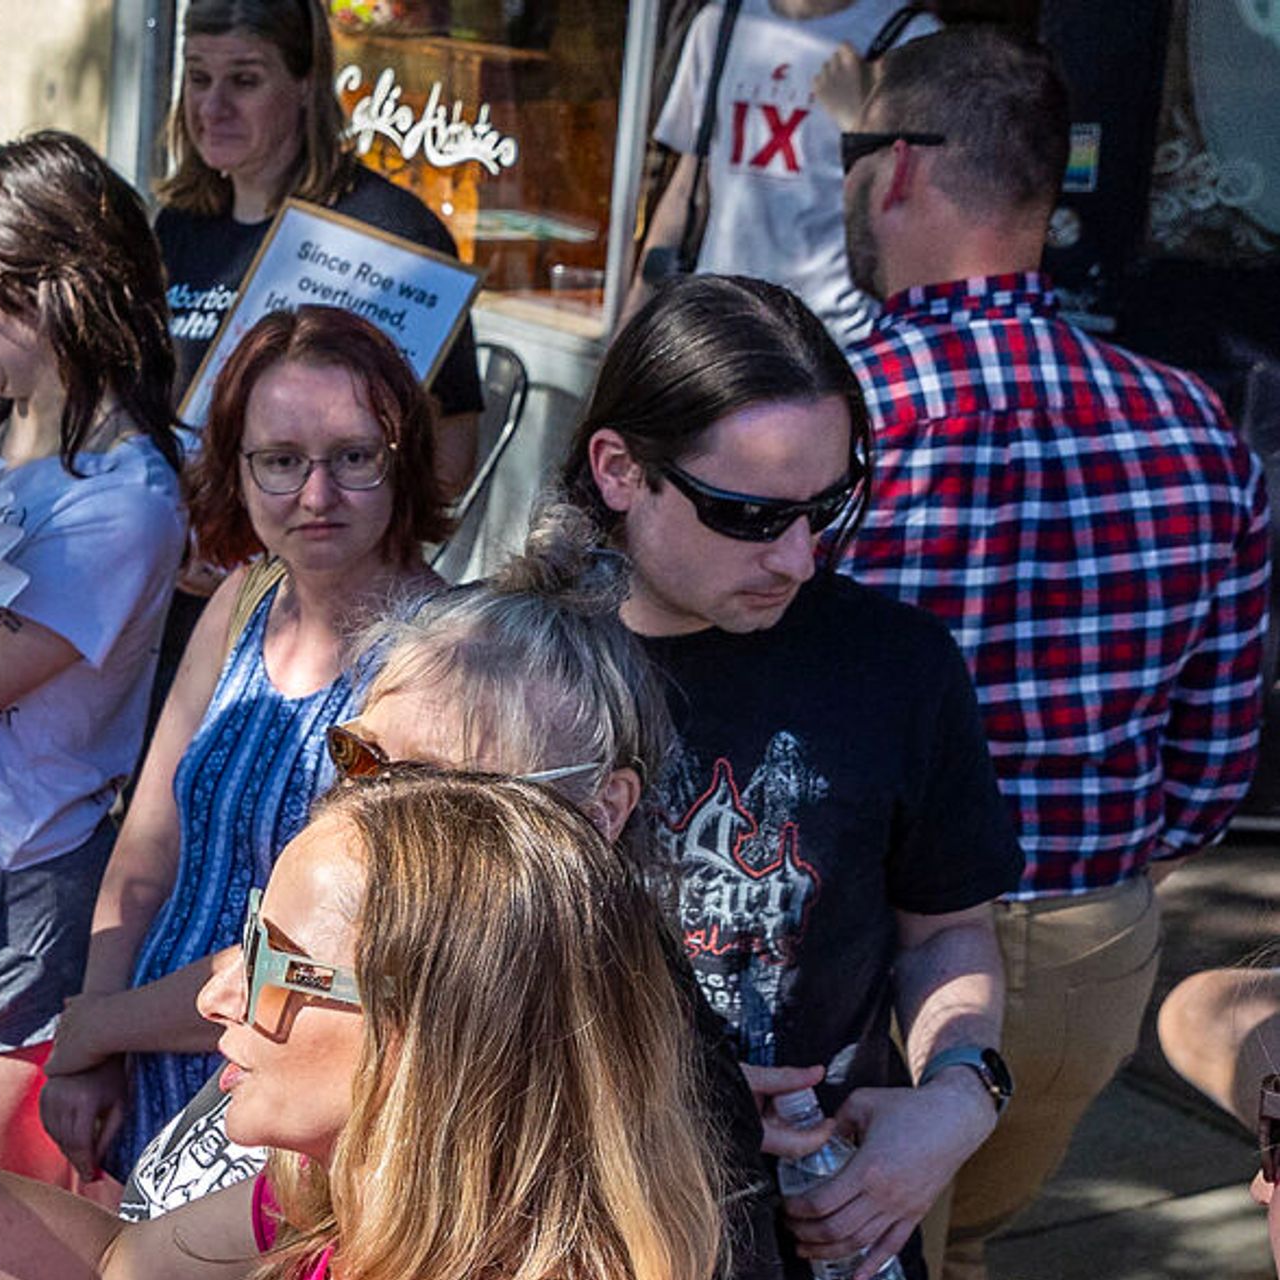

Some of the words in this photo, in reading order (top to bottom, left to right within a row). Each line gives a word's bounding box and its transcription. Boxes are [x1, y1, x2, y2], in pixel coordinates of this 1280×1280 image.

[730, 101, 809, 173] IX
[296, 240, 351, 275] Since
[355, 261, 394, 290] Roe
[397, 281, 438, 308] was
